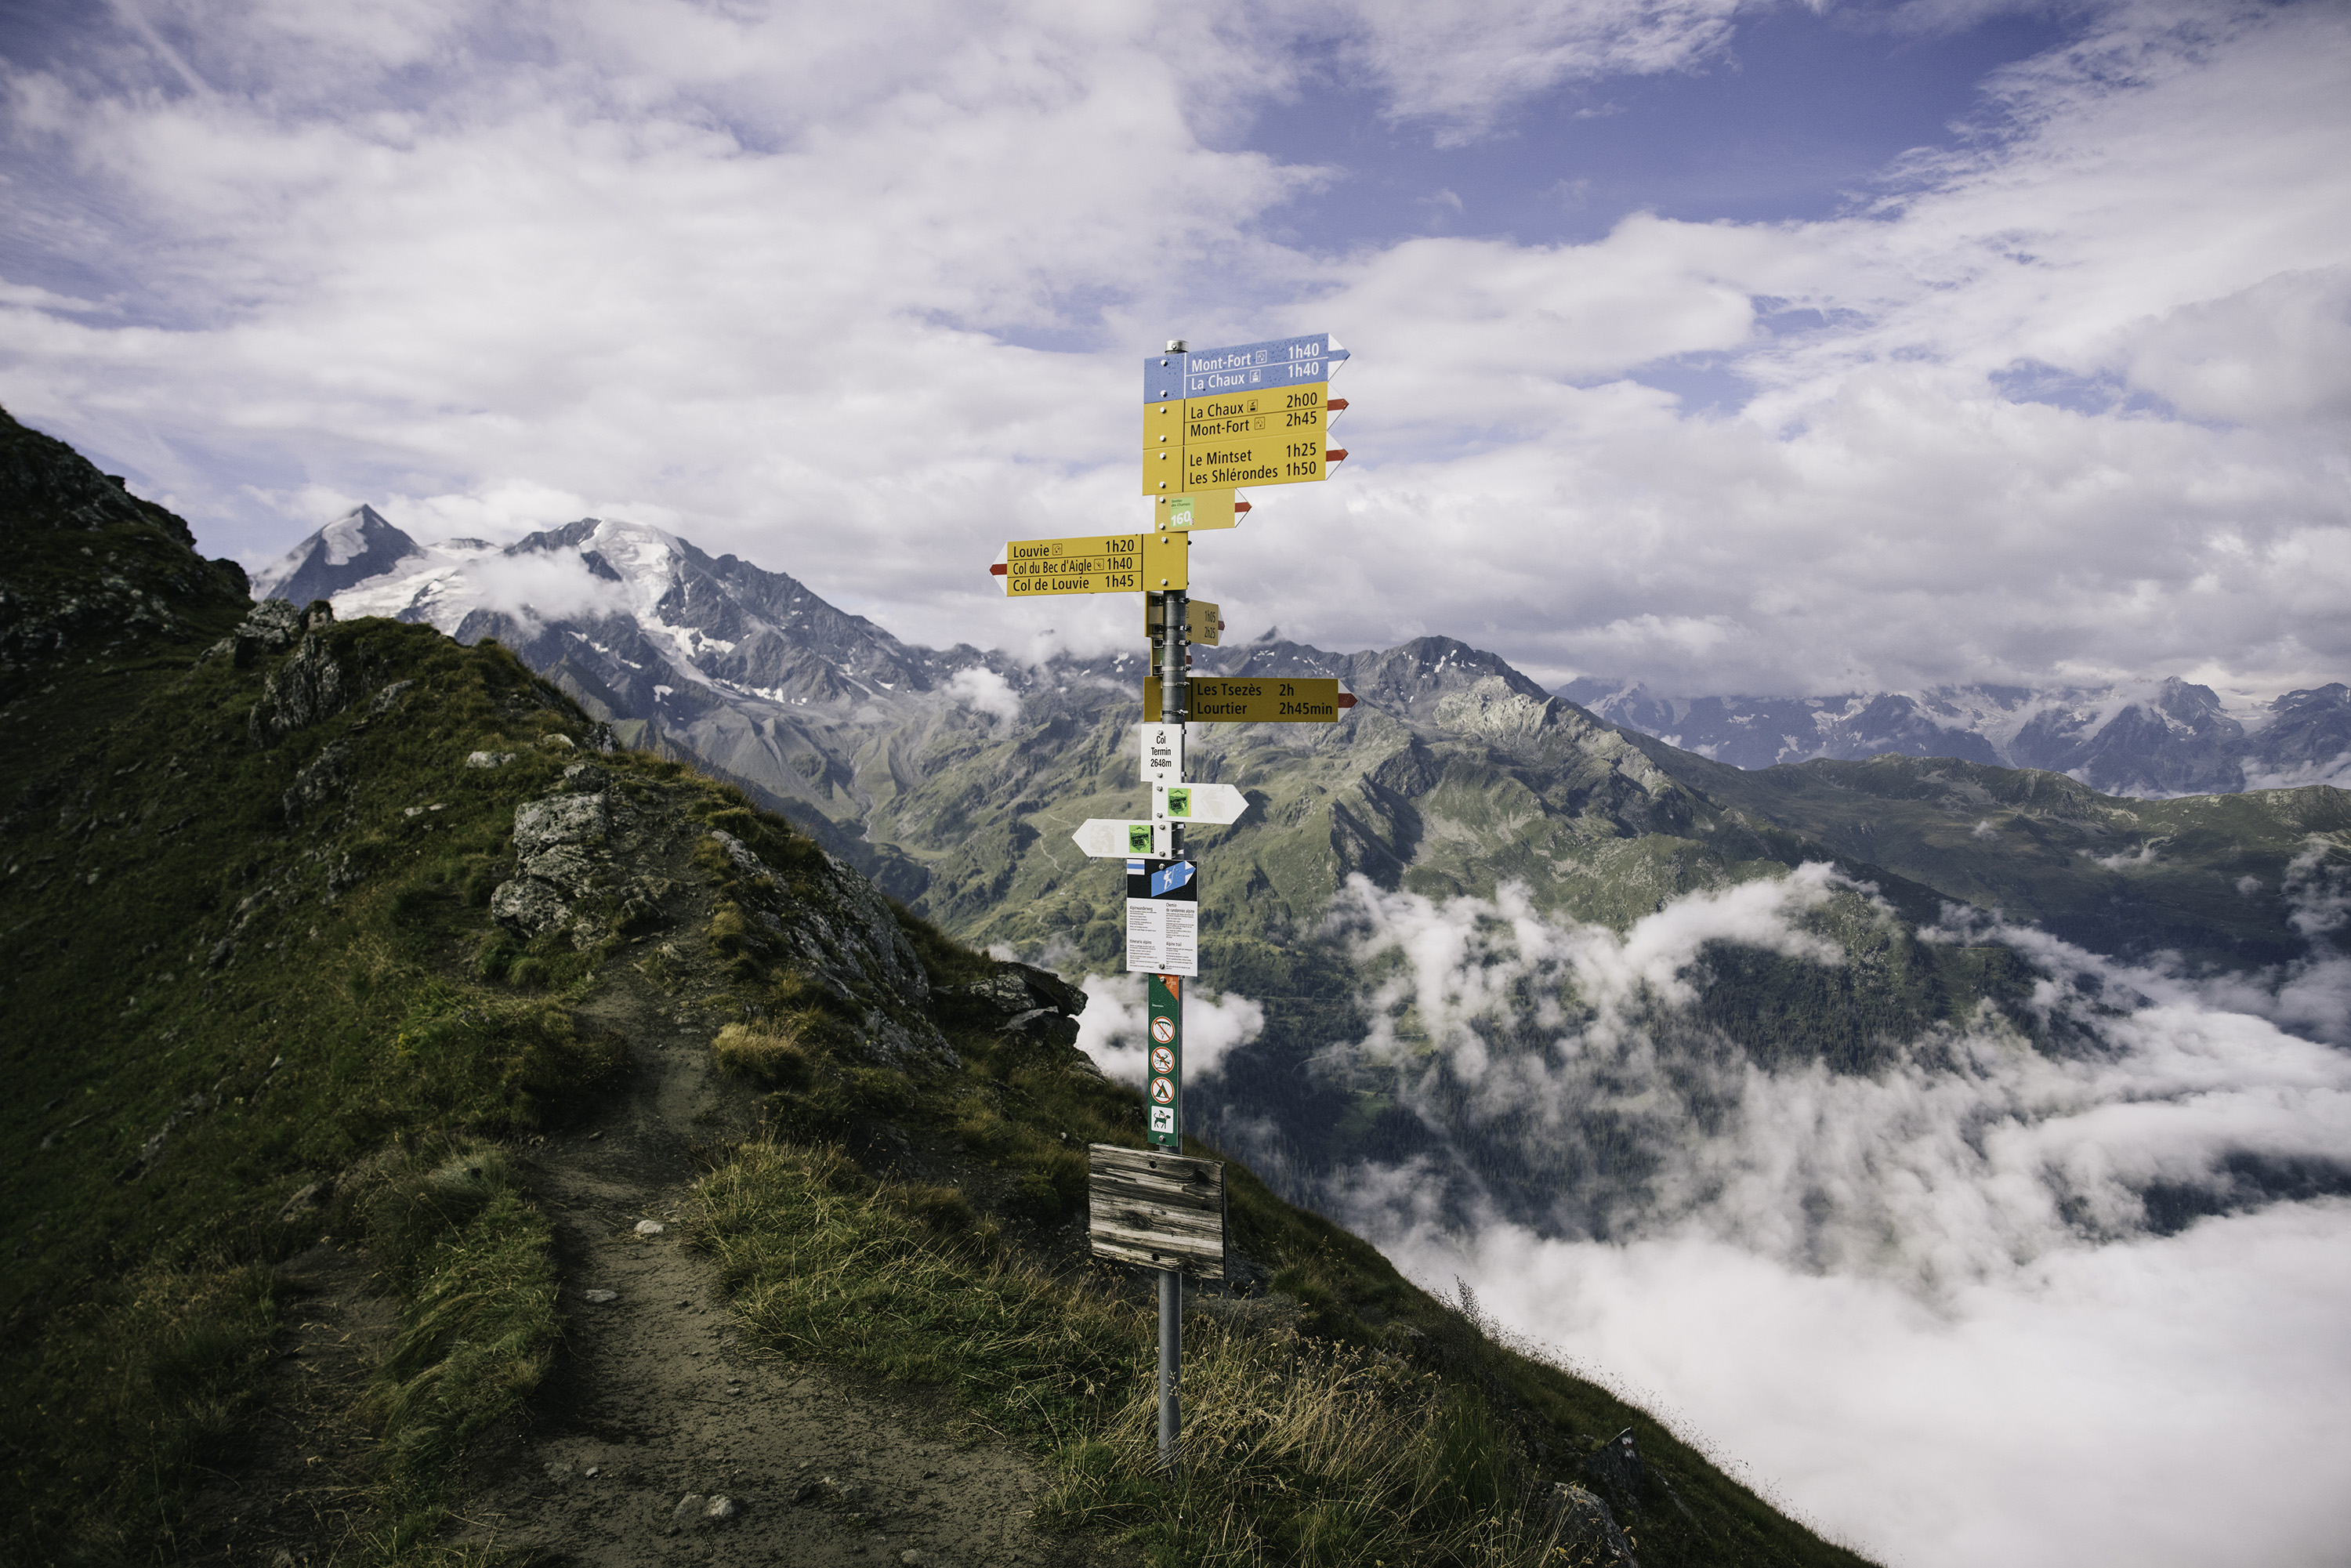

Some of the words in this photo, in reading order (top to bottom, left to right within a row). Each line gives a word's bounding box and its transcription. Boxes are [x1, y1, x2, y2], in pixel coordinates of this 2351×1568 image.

[1191, 353, 1251, 373] Mont-Fort
[1288, 343, 1319, 359] 1h40
[1191, 378, 1204, 390] La
[1208, 373, 1244, 388] Chaux
[1288, 361, 1319, 378] 1h40
[1191, 407, 1203, 419] La
[1208, 402, 1244, 417] Chaux
[1287, 393, 1317, 408] 2h00
[1190, 419, 1249, 436] Mont-Fort
[1286, 411, 1317, 427] 2h45
[1190, 454, 1203, 467] Le
[1207, 449, 1252, 465] Mintset
[1286, 442, 1317, 458] 1h25
[1190, 471, 1208, 485] Les
[1212, 465, 1278, 483] Shlérondes
[1286, 462, 1317, 476] 1h50
[1171, 510, 1191, 527] 160
[1013, 545, 1049, 558] Louvie
[1106, 539, 1134, 552] 1h20
[1012, 562, 1027, 574] Col
[1029, 561, 1040, 574] du
[1043, 561, 1058, 573] Bec
[1060, 559, 1092, 574] d'Aigle
[1107, 557, 1132, 570] 1h40
[1012, 578, 1031, 591] Col
[1034, 578, 1048, 590] de
[1052, 577, 1089, 589] Louvie
[1106, 574, 1134, 587] 1h45
[1204, 610, 1215, 622] 1h05
[1204, 626, 1215, 639] 2h25
[1197, 683, 1217, 695] Les
[1221, 683, 1262, 696] Tsezès
[1279, 684, 1294, 696] 2h
[1197, 701, 1247, 714] Lourtier
[1279, 702, 1332, 715] 2h45min
[1156, 735, 1166, 744] Col
[1150, 747, 1172, 755] Termin
[1150, 759, 1172, 767] 2648m
